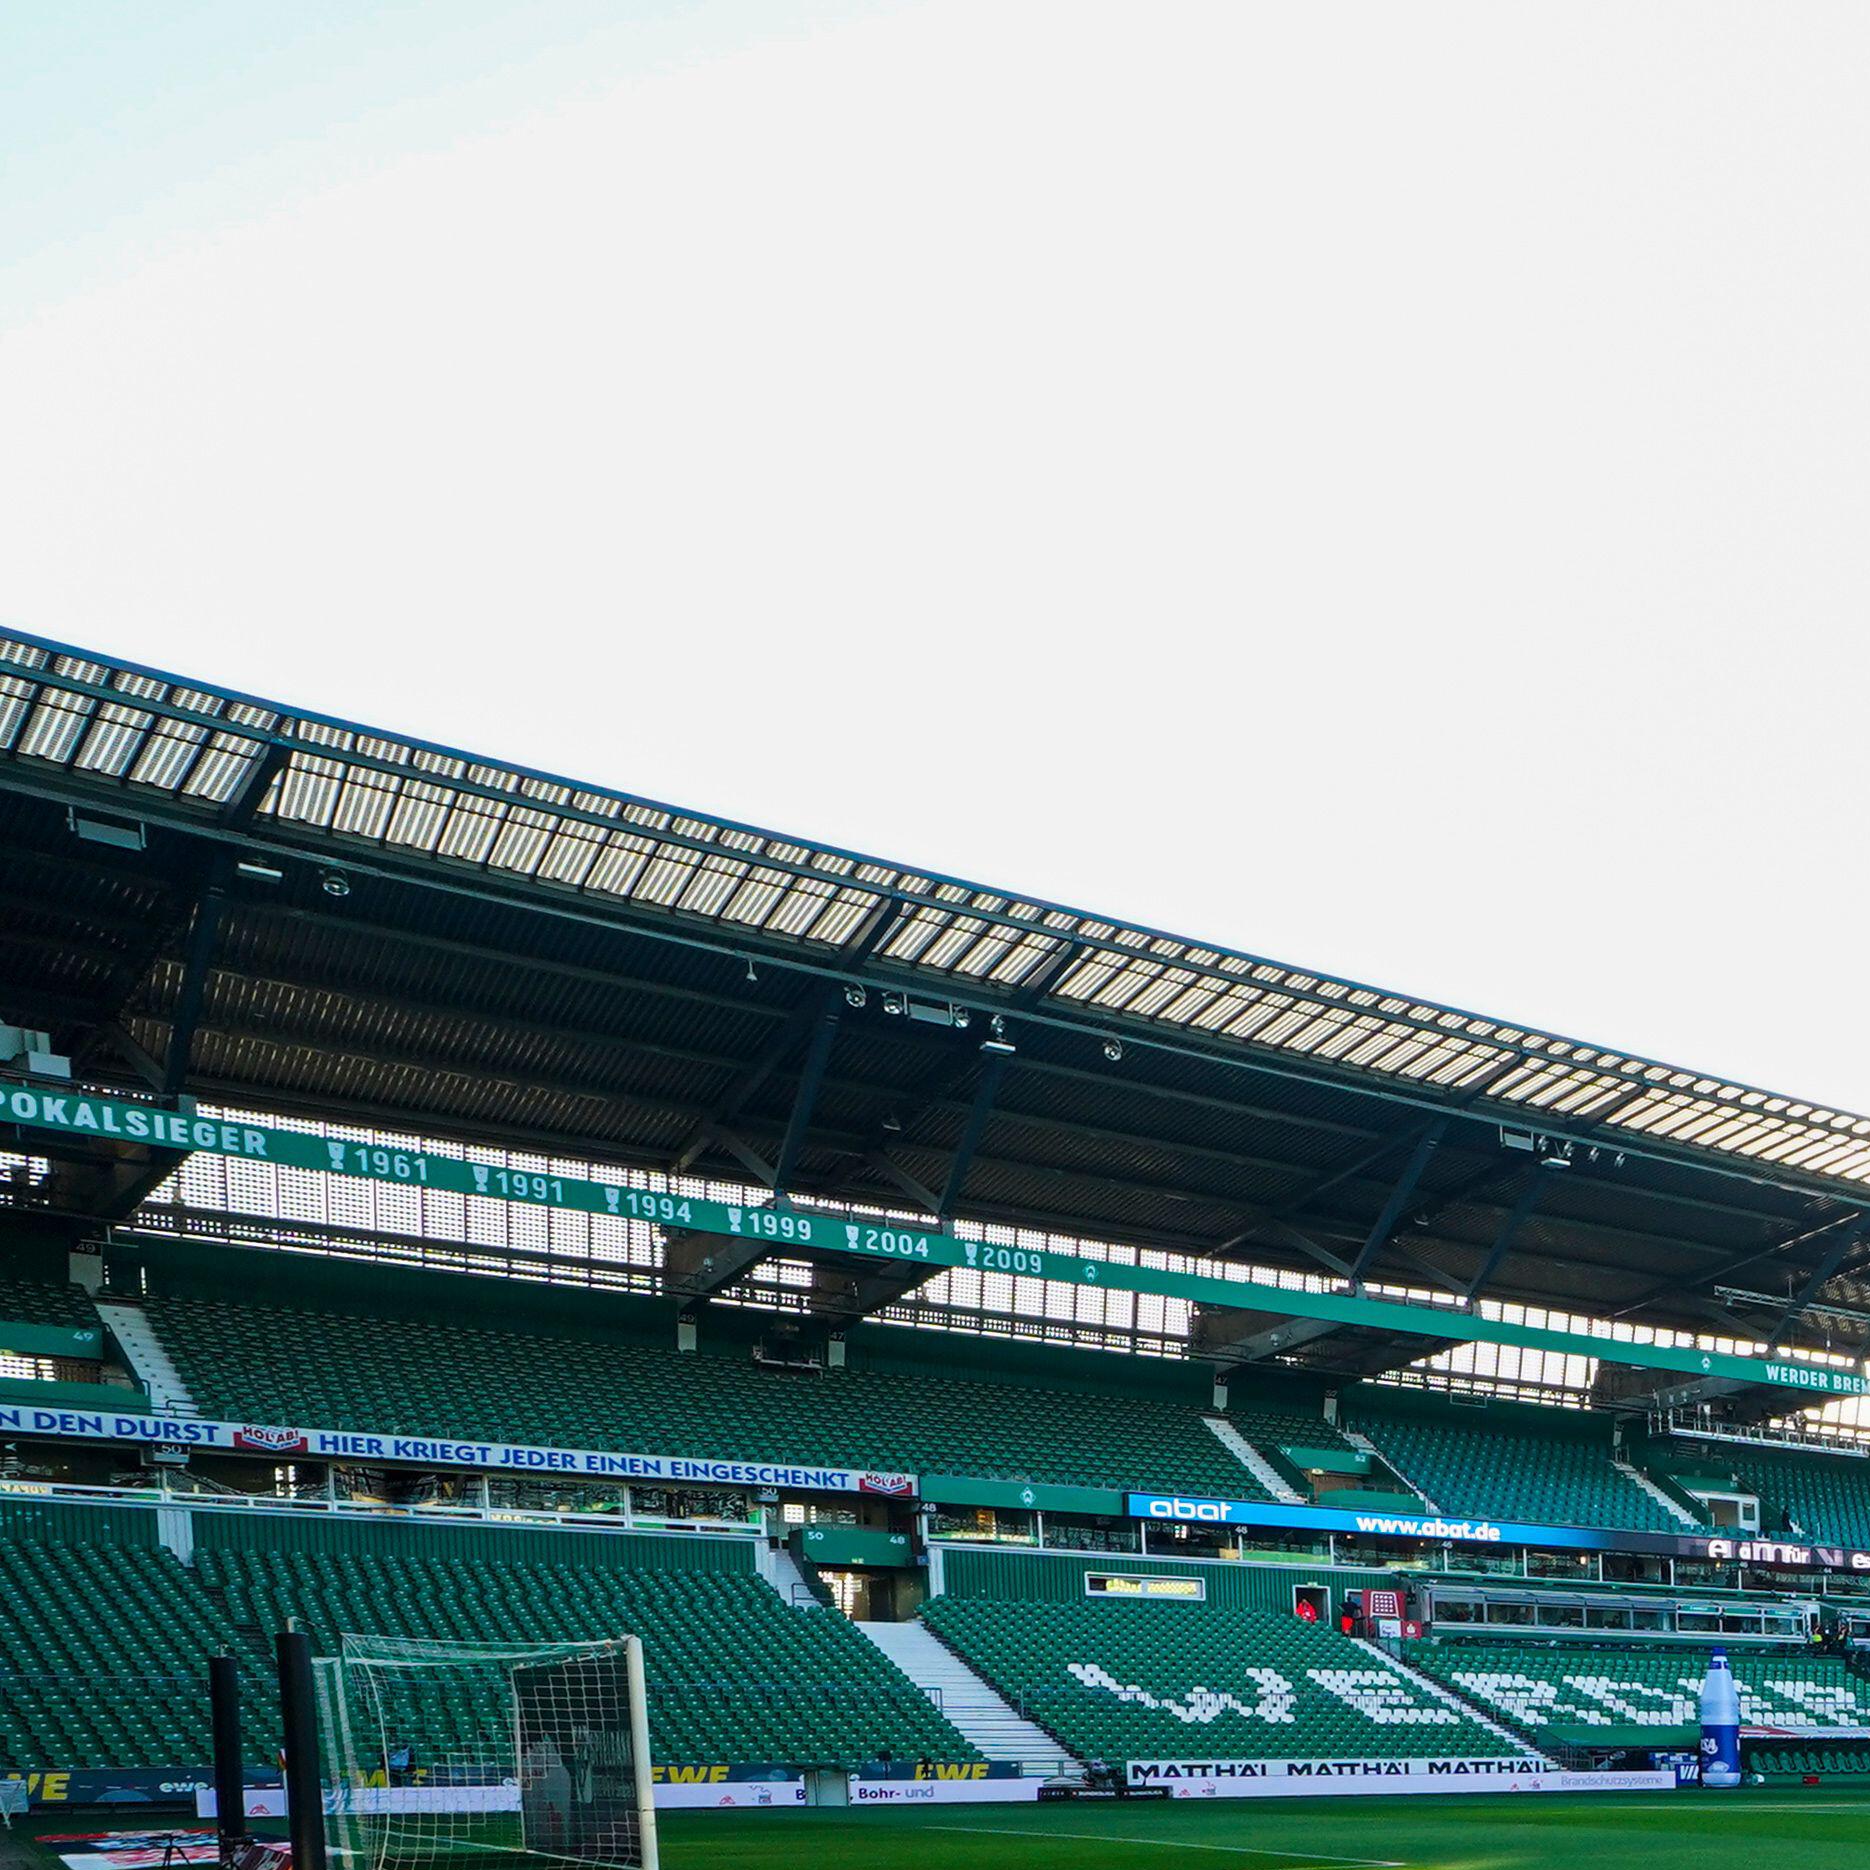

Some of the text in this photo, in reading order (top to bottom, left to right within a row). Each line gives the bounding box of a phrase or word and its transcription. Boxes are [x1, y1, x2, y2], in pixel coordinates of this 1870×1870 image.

[0, 1090, 268, 1157] OKALSIEGER
[354, 1148, 428, 1181] 1961
[496, 1169, 563, 1203] 1991
[626, 1192, 691, 1224] 1994
[749, 1211, 812, 1241] 1999
[865, 1230, 929, 1258] 2004
[982, 1246, 1043, 1274] 2009
[1766, 1364, 1829, 1389] WERDER
[34, 1411, 103, 1435] DEN
[115, 1417, 220, 1443] DURST
[319, 1433, 849, 1490] HIER KRIEGT JEDER EINEN EINGESCHENKT
[1149, 1498, 1232, 1520] abat
[807, 1531, 825, 1541] 50
[1356, 1516, 1502, 1541] www.abat.de
[1131, 1760, 1541, 1778] MATTHÄI MATTHÄI MATTHÄI
[1560, 1774, 1664, 1788] Brandschutzsysteme
[858, 1786, 935, 1799] Bohr- und
